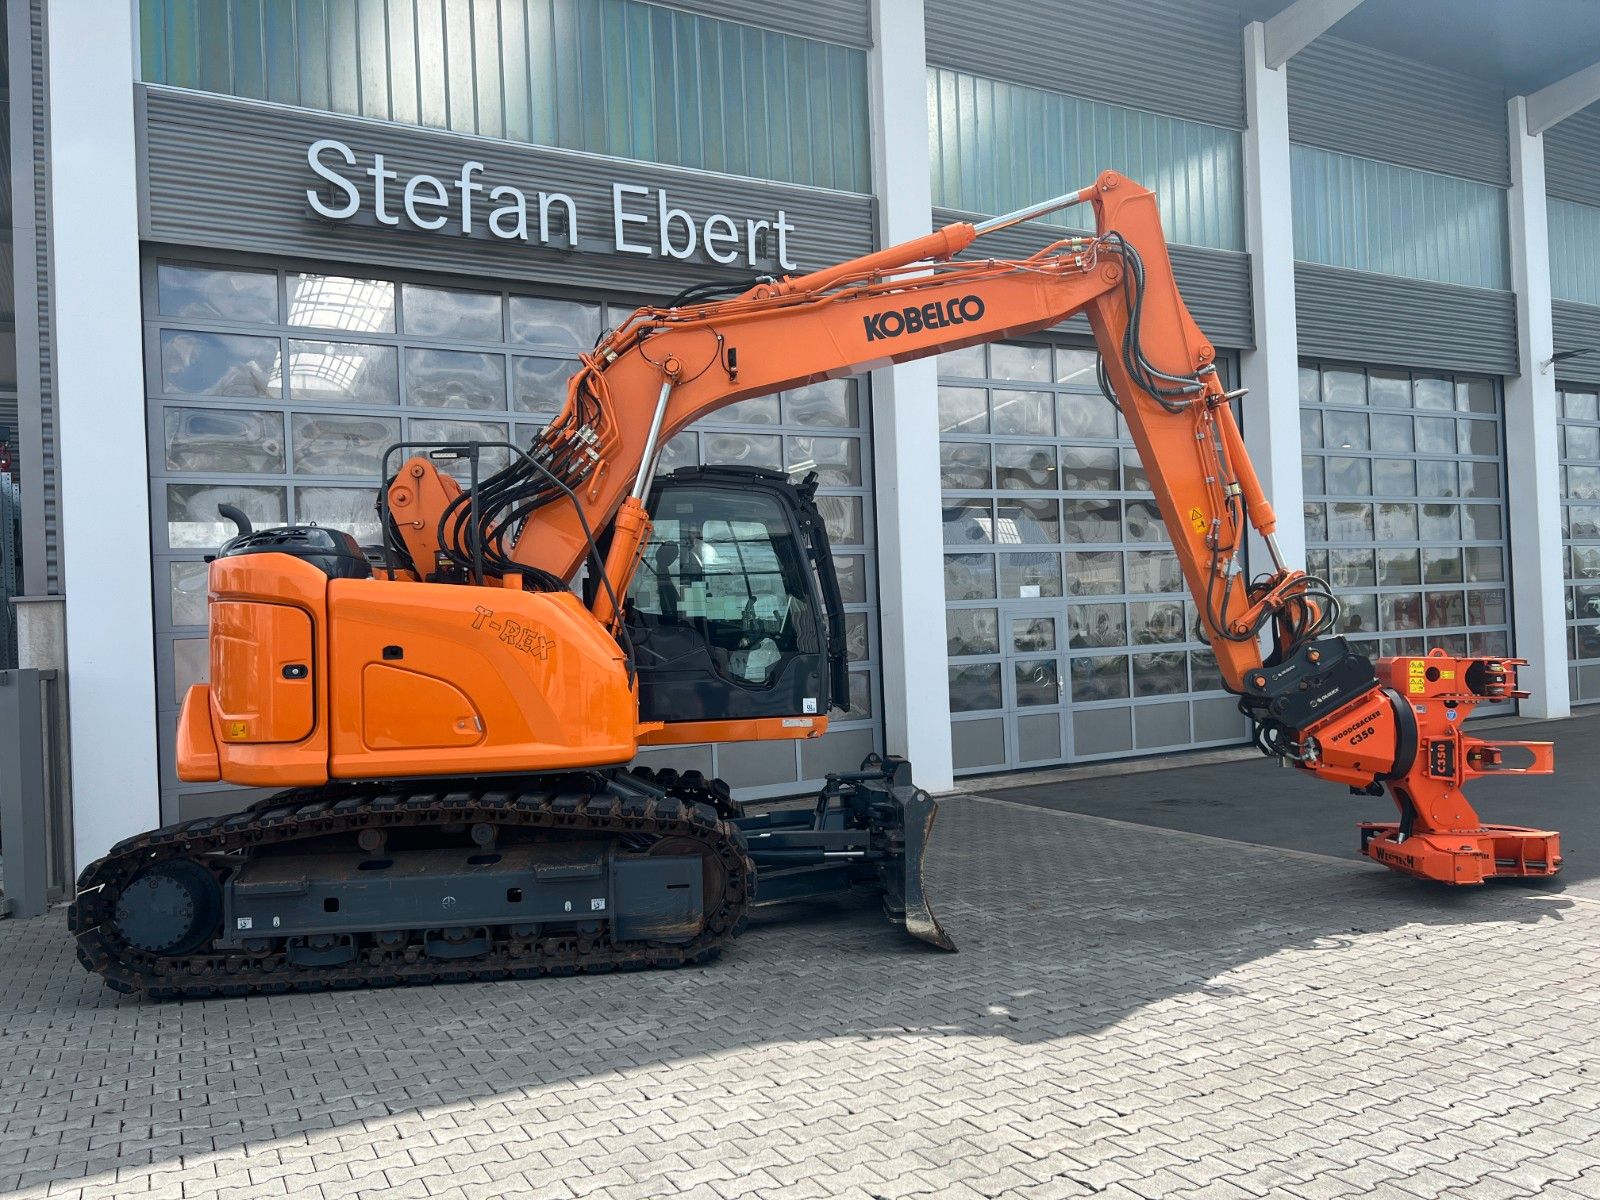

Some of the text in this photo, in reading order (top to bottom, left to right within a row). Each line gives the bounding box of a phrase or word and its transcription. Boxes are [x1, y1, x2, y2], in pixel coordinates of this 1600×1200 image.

[306, 139, 797, 271] Stefan Ebert
[863, 295, 985, 342] KOBELCO
[472, 605, 556, 660] T-REX
[1331, 710, 1382, 742] WOODCRACKER
[1349, 727, 1375, 746] C350
[1437, 744, 1446, 773] C350
